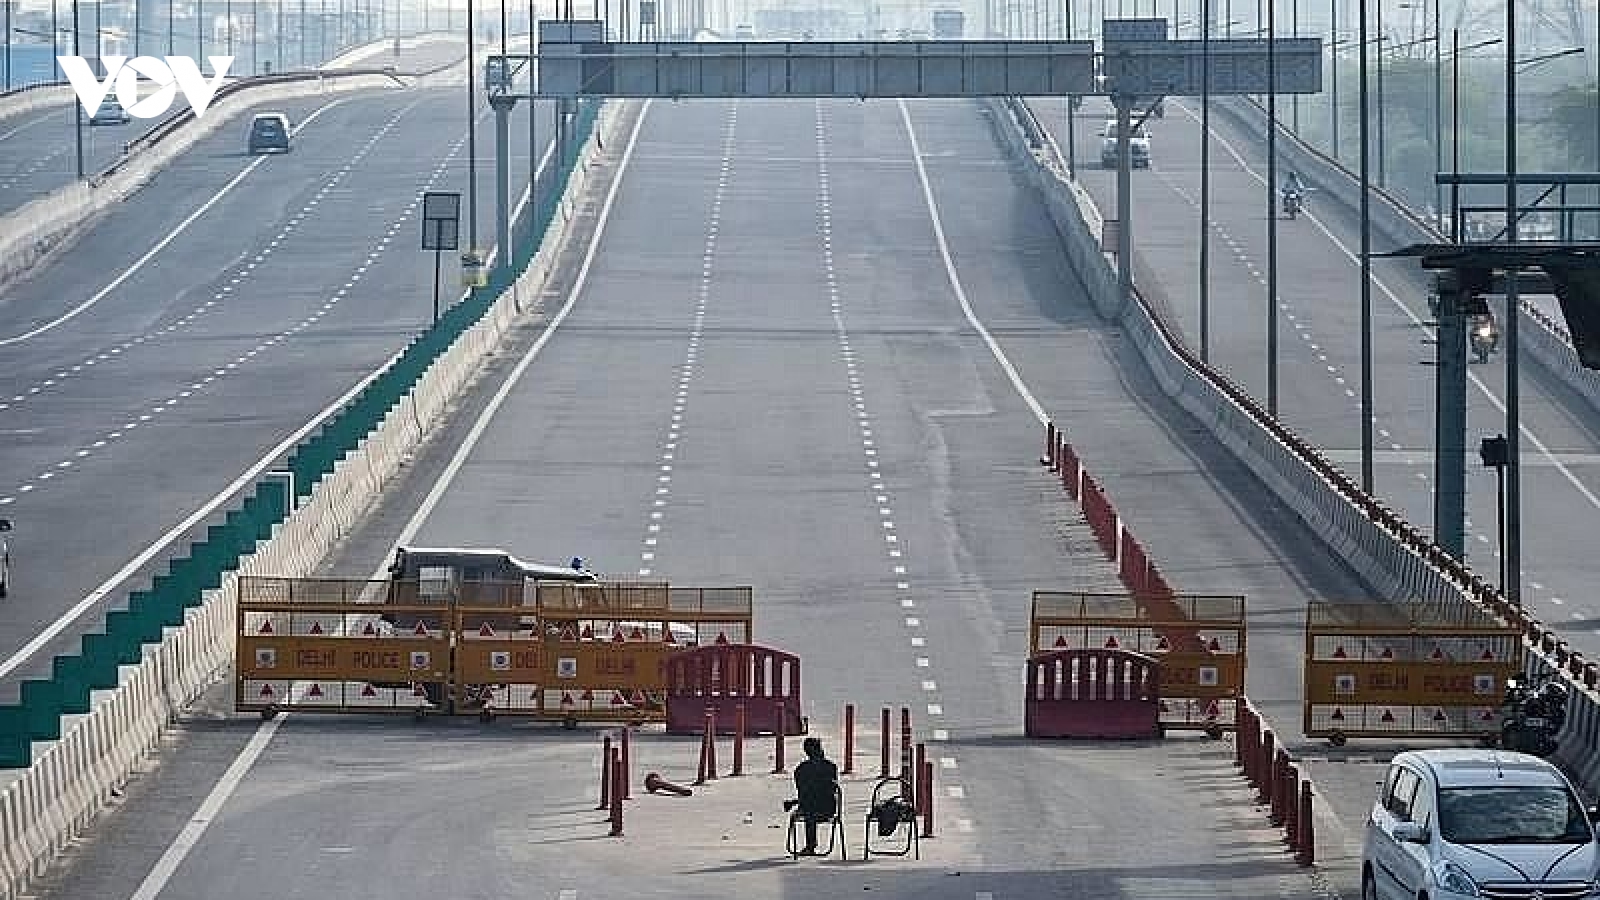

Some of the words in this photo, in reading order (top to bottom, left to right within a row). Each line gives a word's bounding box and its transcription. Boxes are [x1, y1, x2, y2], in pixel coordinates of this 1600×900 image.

[296, 650, 335, 669] DELHI
[353, 651, 400, 669] POLICE
[1423, 674, 1473, 692] POLICE
